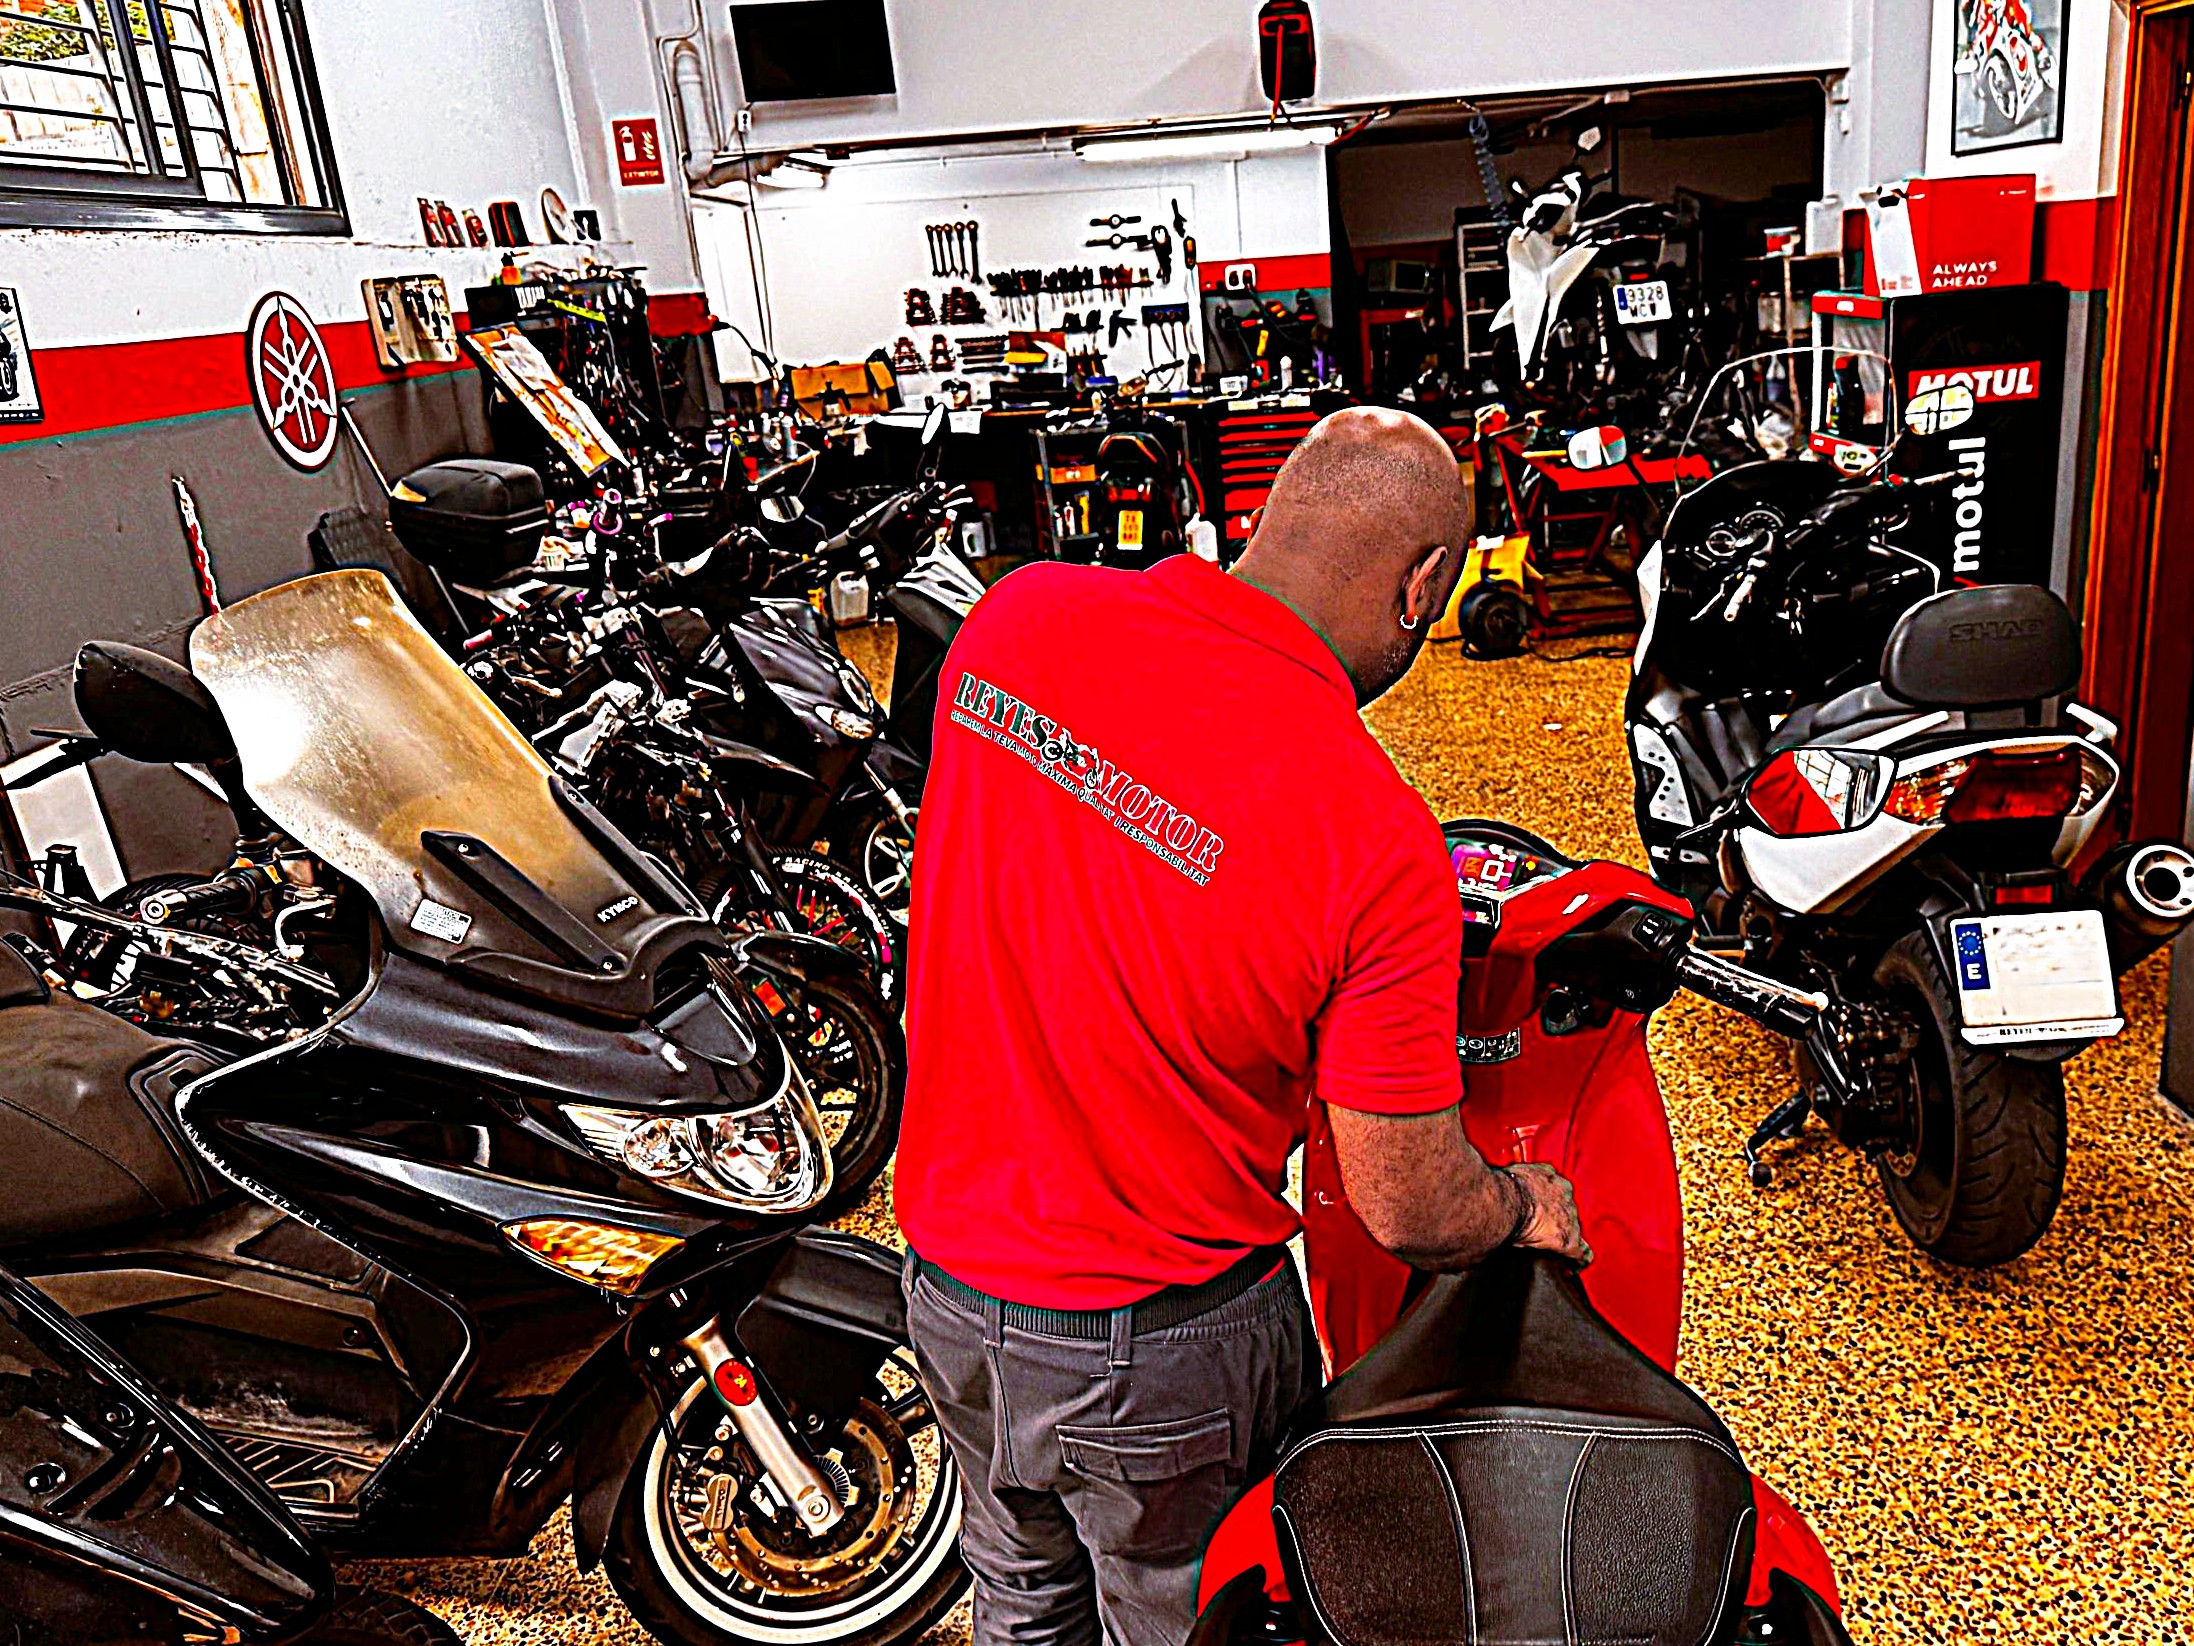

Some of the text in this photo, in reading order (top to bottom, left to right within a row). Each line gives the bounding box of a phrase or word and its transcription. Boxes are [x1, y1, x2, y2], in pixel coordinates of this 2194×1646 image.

[1932, 261, 1997, 275] ALWAYS
[1931, 275, 1988, 288] AHEAD
[1627, 286, 1664, 302] 9328
[1948, 437, 1986, 572] motul
[954, 672, 1224, 872] REYES MOTOR
[993, 731, 1017, 753] TEVA
[1119, 820, 1210, 887] RESPONSABILITAT
[597, 896, 638, 922] KYMCO
[1966, 963, 1982, 980] E
